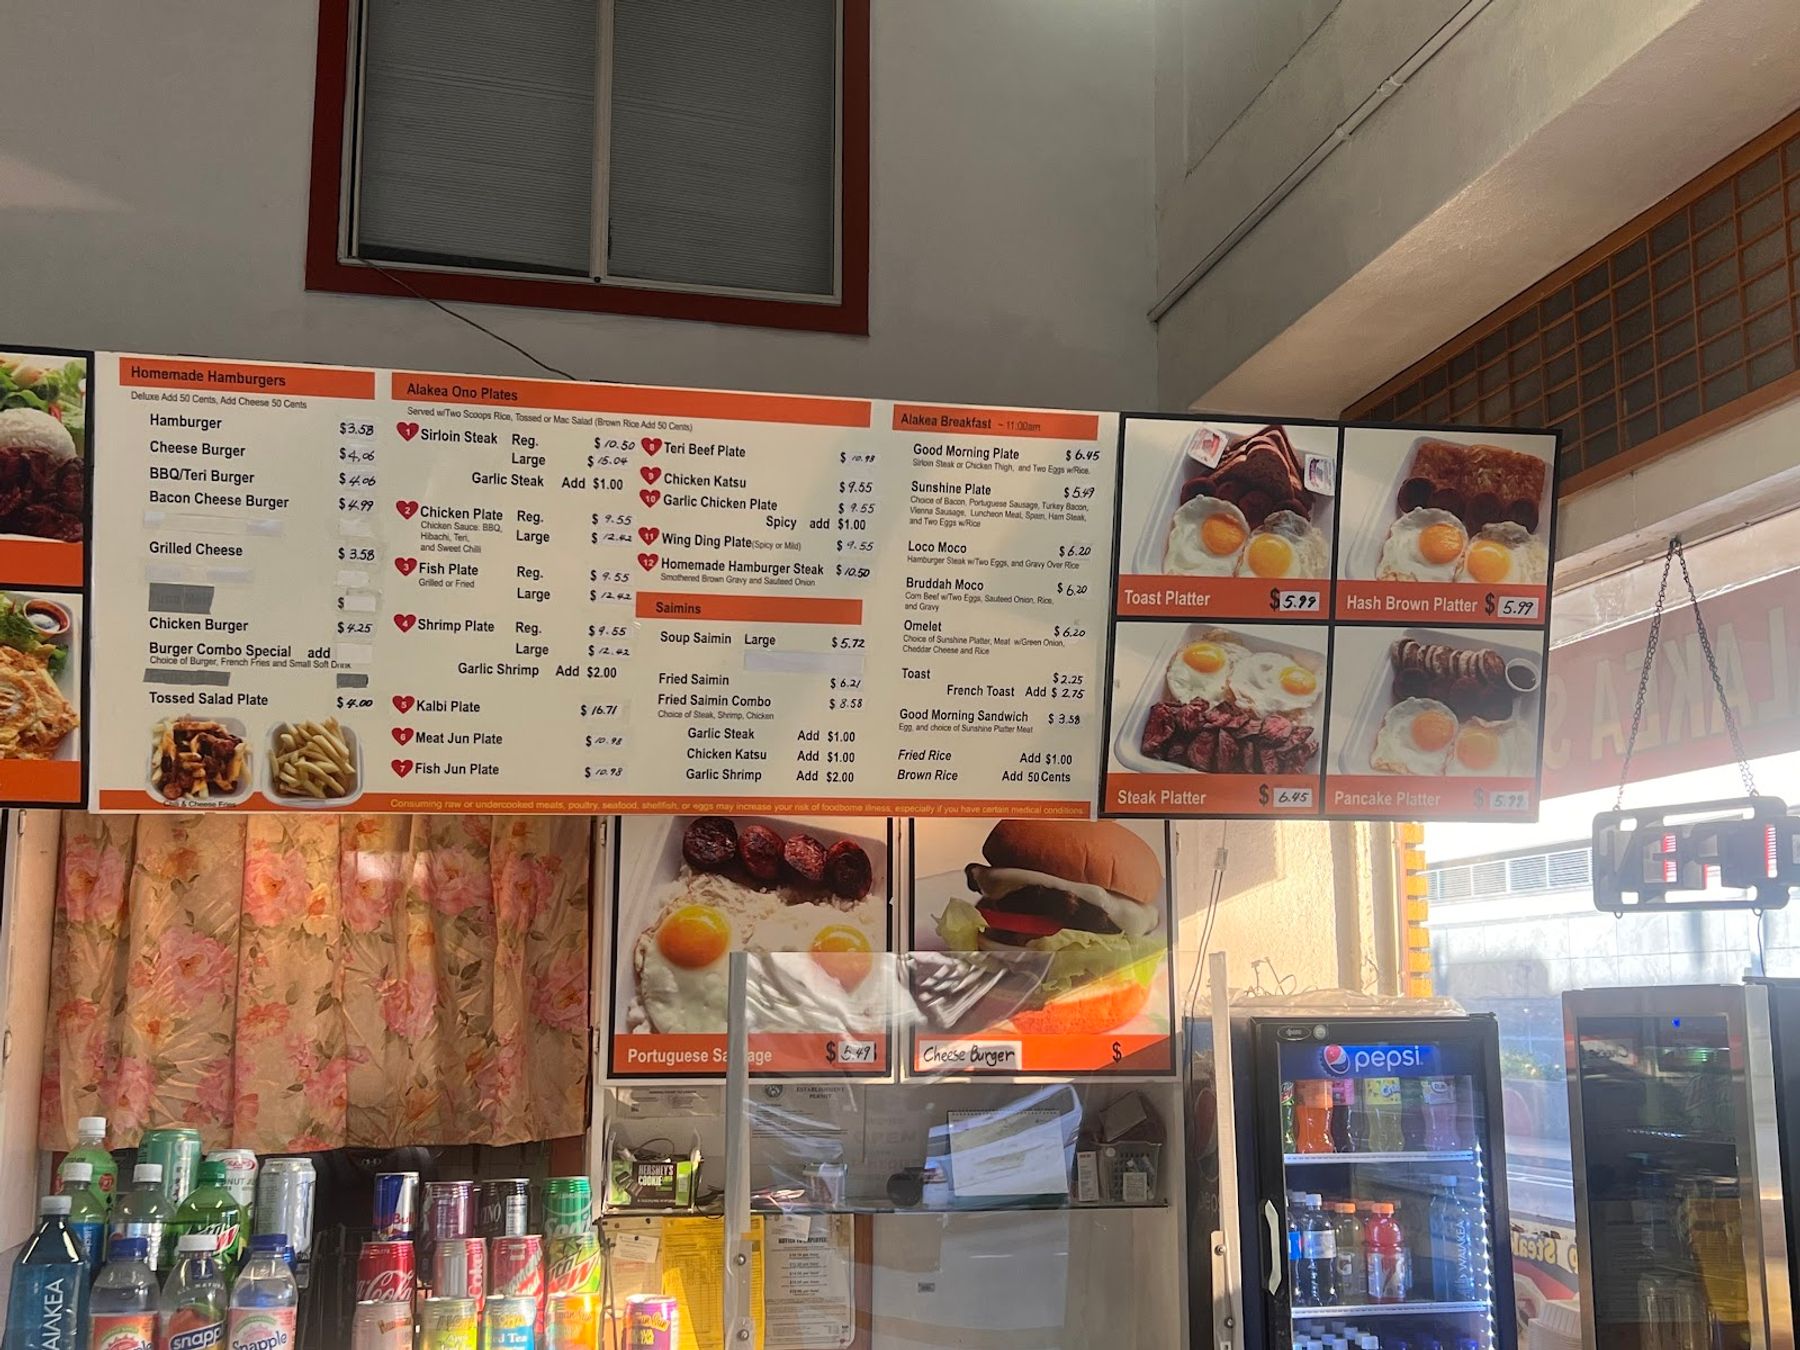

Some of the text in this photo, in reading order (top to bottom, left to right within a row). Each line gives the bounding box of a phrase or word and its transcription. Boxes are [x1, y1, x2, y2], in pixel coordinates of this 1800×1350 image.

[131, 366, 286, 388] Homemade Hamburgers
[131, 391, 159, 401] Deluxe
[161, 393, 178, 402] Add
[179, 393, 190, 402] 50
[220, 396, 236, 405] Add
[238, 397, 269, 407] Cheese
[272, 398, 282, 408] 50
[283, 399, 307, 409] Cents
[407, 383, 518, 401] Alakea Ono Plates
[150, 413, 222, 431] Hamburger
[407, 406, 435, 416] Served
[463, 409, 492, 421] Scoops
[515, 412, 542, 423] Tossed
[553, 415, 569, 424] Mac
[571, 416, 593, 425] Salad
[623, 419, 639, 428] Rice
[640, 420, 656, 429] Add
[658, 421, 667, 430] 50
[901, 413, 937, 426] Alakea
[940, 415, 991, 429] Breakfast
[421, 428, 538, 449] Sirloin Steak Reg.
[150, 440, 246, 459] Cheese Burger
[664, 441, 746, 457] Teri Beef Plate
[913, 443, 1019, 461] Good Morning Plate
[512, 452, 546, 468] Large
[150, 467, 255, 486] BBQ/Teri Burger
[472, 472, 623, 490] Garlic Steak Add $1.00
[664, 473, 746, 488] Chicken Katsu
[911, 480, 991, 495] Sunshine Plate
[150, 490, 289, 510] Bacon Cheese Burger
[149, 541, 243, 556] Grilled Cheese
[662, 533, 691, 548] Wing
[695, 534, 720, 549] Ding
[724, 535, 753, 548] Plate
[908, 540, 967, 554] Loco Moco
[419, 562, 478, 576] Fish Plate
[661, 557, 824, 576] Homemade Hamburger Steak
[907, 555, 945, 566] Hamburger
[946, 556, 966, 565] Steak
[1025, 559, 1045, 569] Gravy
[1046, 560, 1063, 568] Over
[1064, 561, 1080, 569] Rice
[906, 577, 984, 591] Bruddah Moco
[1124, 589, 1211, 606] Toast Platter
[1347, 595, 1478, 612] Hash Brown Platter
[656, 601, 701, 614] Saimins
[418, 618, 495, 634] Shrimp Plate
[904, 620, 942, 632] Omelet
[660, 631, 776, 648] Soup Saimin Large
[149, 642, 330, 660] Burger Combo Special add
[902, 668, 930, 679] Toast
[149, 691, 268, 706] Tossed Salad Plate
[947, 684, 1046, 697] French Toast Add
[417, 700, 480, 712] Kalbi Plate
[658, 693, 771, 707] Fried Saimin Combo
[898, 749, 952, 761] Fried Rice
[1118, 790, 1207, 805] Steak Platter
[1334, 790, 1440, 807] Pancake Platter
[961, 805, 981, 813] have
[627, 1047, 773, 1069] Portuguese Saage
[923, 1045, 1015, 1067] Cheese Burger
[1355, 1045, 1420, 1072] pepsi
[42, 1278, 65, 1350] AIAKEA
[172, 1327, 223, 1350] snapp
[232, 1330, 288, 1350] Snapple
